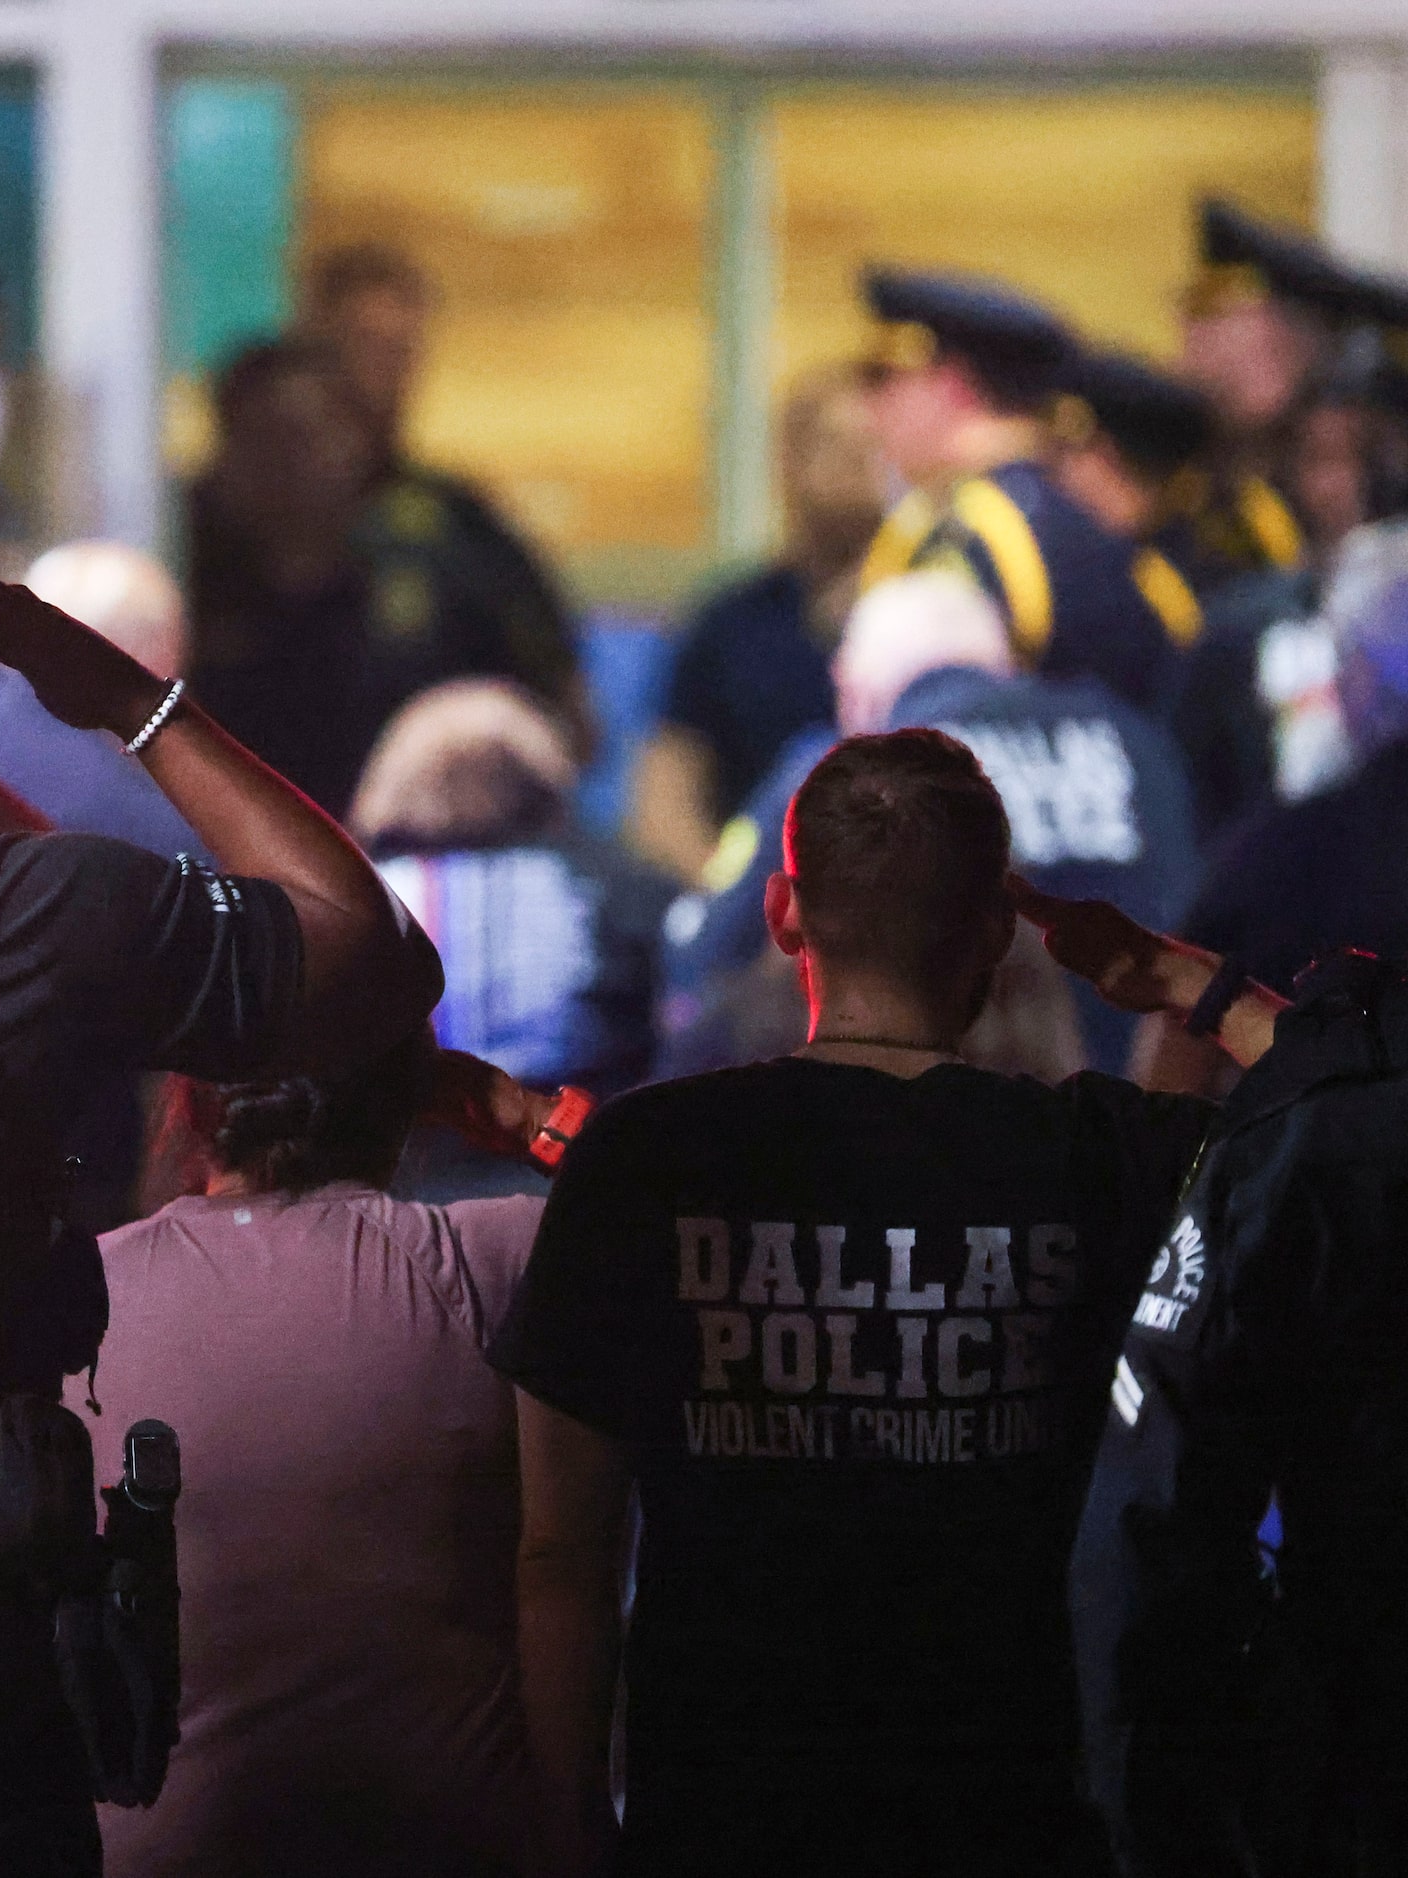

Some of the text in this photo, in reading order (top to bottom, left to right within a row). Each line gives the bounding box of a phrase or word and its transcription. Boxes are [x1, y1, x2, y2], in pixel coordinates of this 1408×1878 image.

[676, 1216, 1078, 1311] DALLAS
[697, 1309, 1054, 1399] POLICE
[682, 1399, 1049, 1465] VIOLENT CRIME UN
